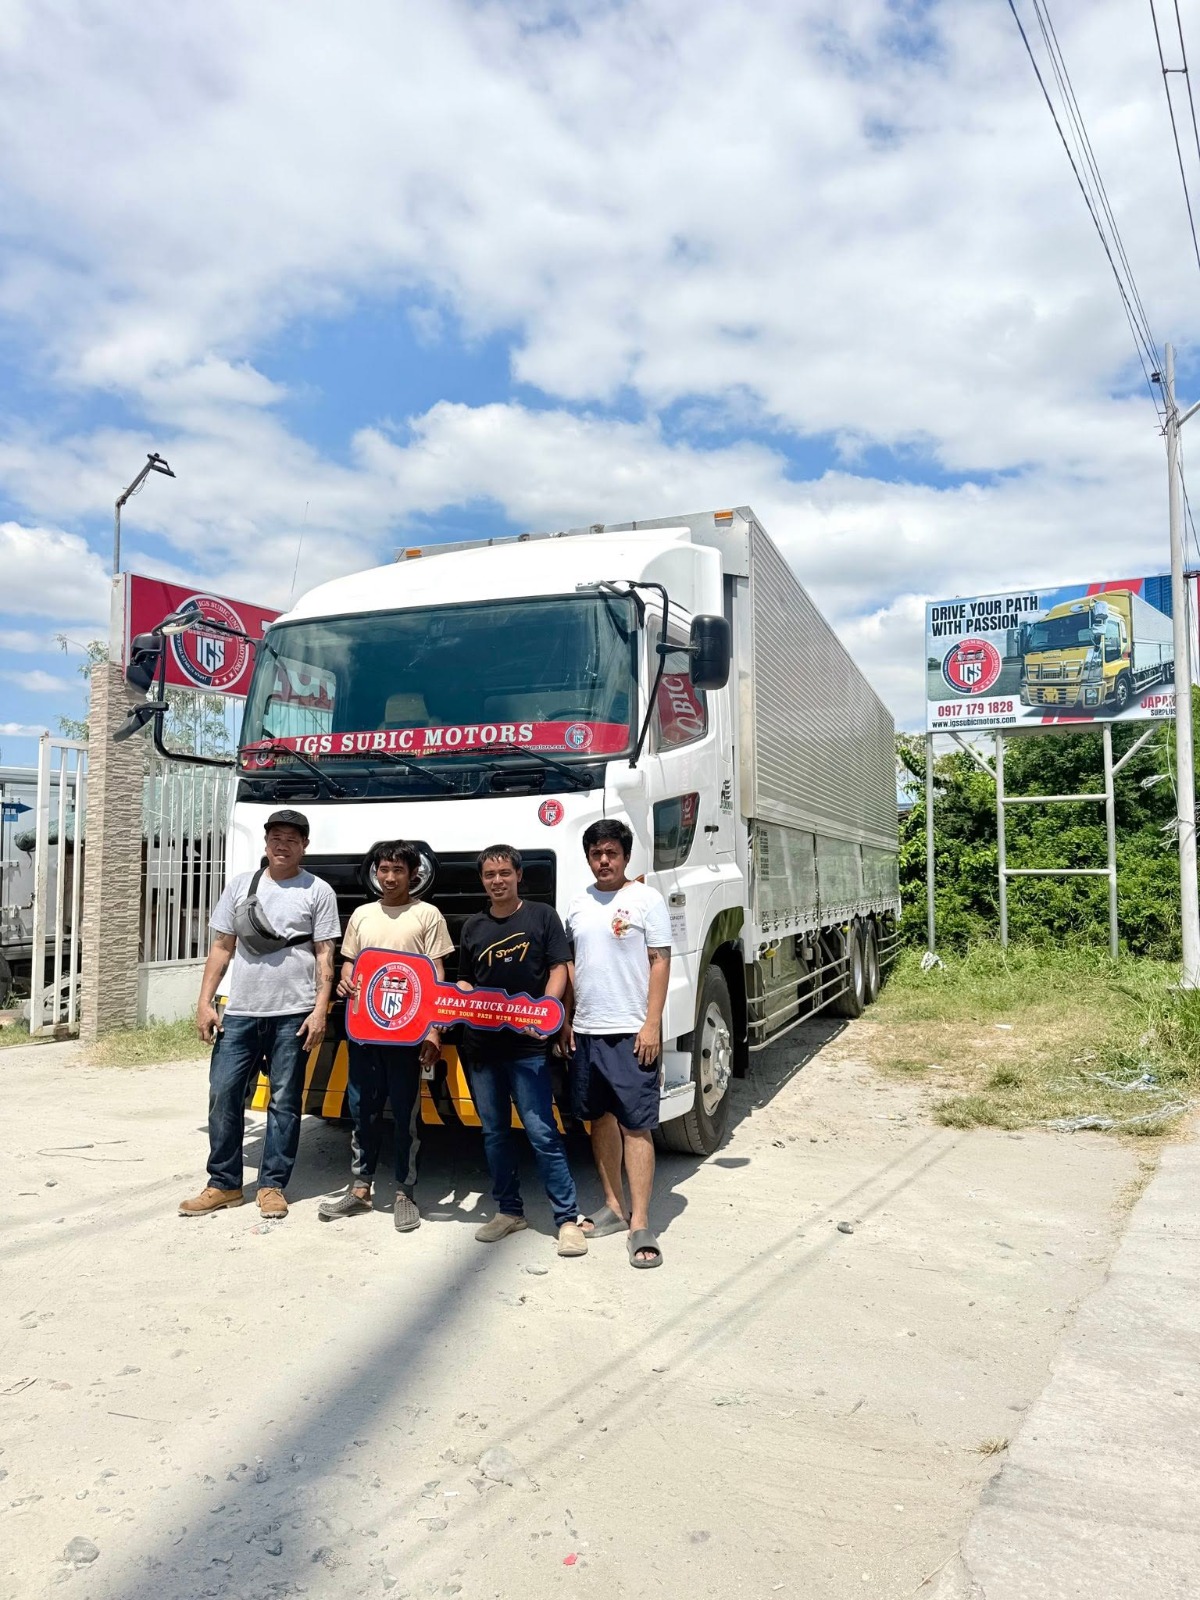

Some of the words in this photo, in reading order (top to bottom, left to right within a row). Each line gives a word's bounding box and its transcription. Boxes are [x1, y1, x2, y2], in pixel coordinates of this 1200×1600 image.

[932, 604, 965, 622] DRIVE
[970, 600, 1001, 617] YOUR
[1006, 596, 1038, 613] PATH
[932, 620, 961, 636] WITH
[966, 614, 1018, 633] PASSION
[196, 636, 225, 673] IGS
[959, 663, 982, 685] IGS
[938, 705, 962, 717] 0917
[966, 703, 984, 715] 179
[988, 701, 1014, 713] 1828
[932, 716, 1017, 728] www.igssubicmotors.com
[295, 736, 332, 754] IGS
[340, 730, 413, 751] SUBIC
[423, 724, 533, 747] MOTORS
[381, 991, 403, 1018] IGS
[434, 996, 468, 1008] JAPAN
[470, 999, 503, 1012] TRUCK
[506, 1003, 549, 1017] DEALER
[437, 1008, 456, 1016] DRIVE
